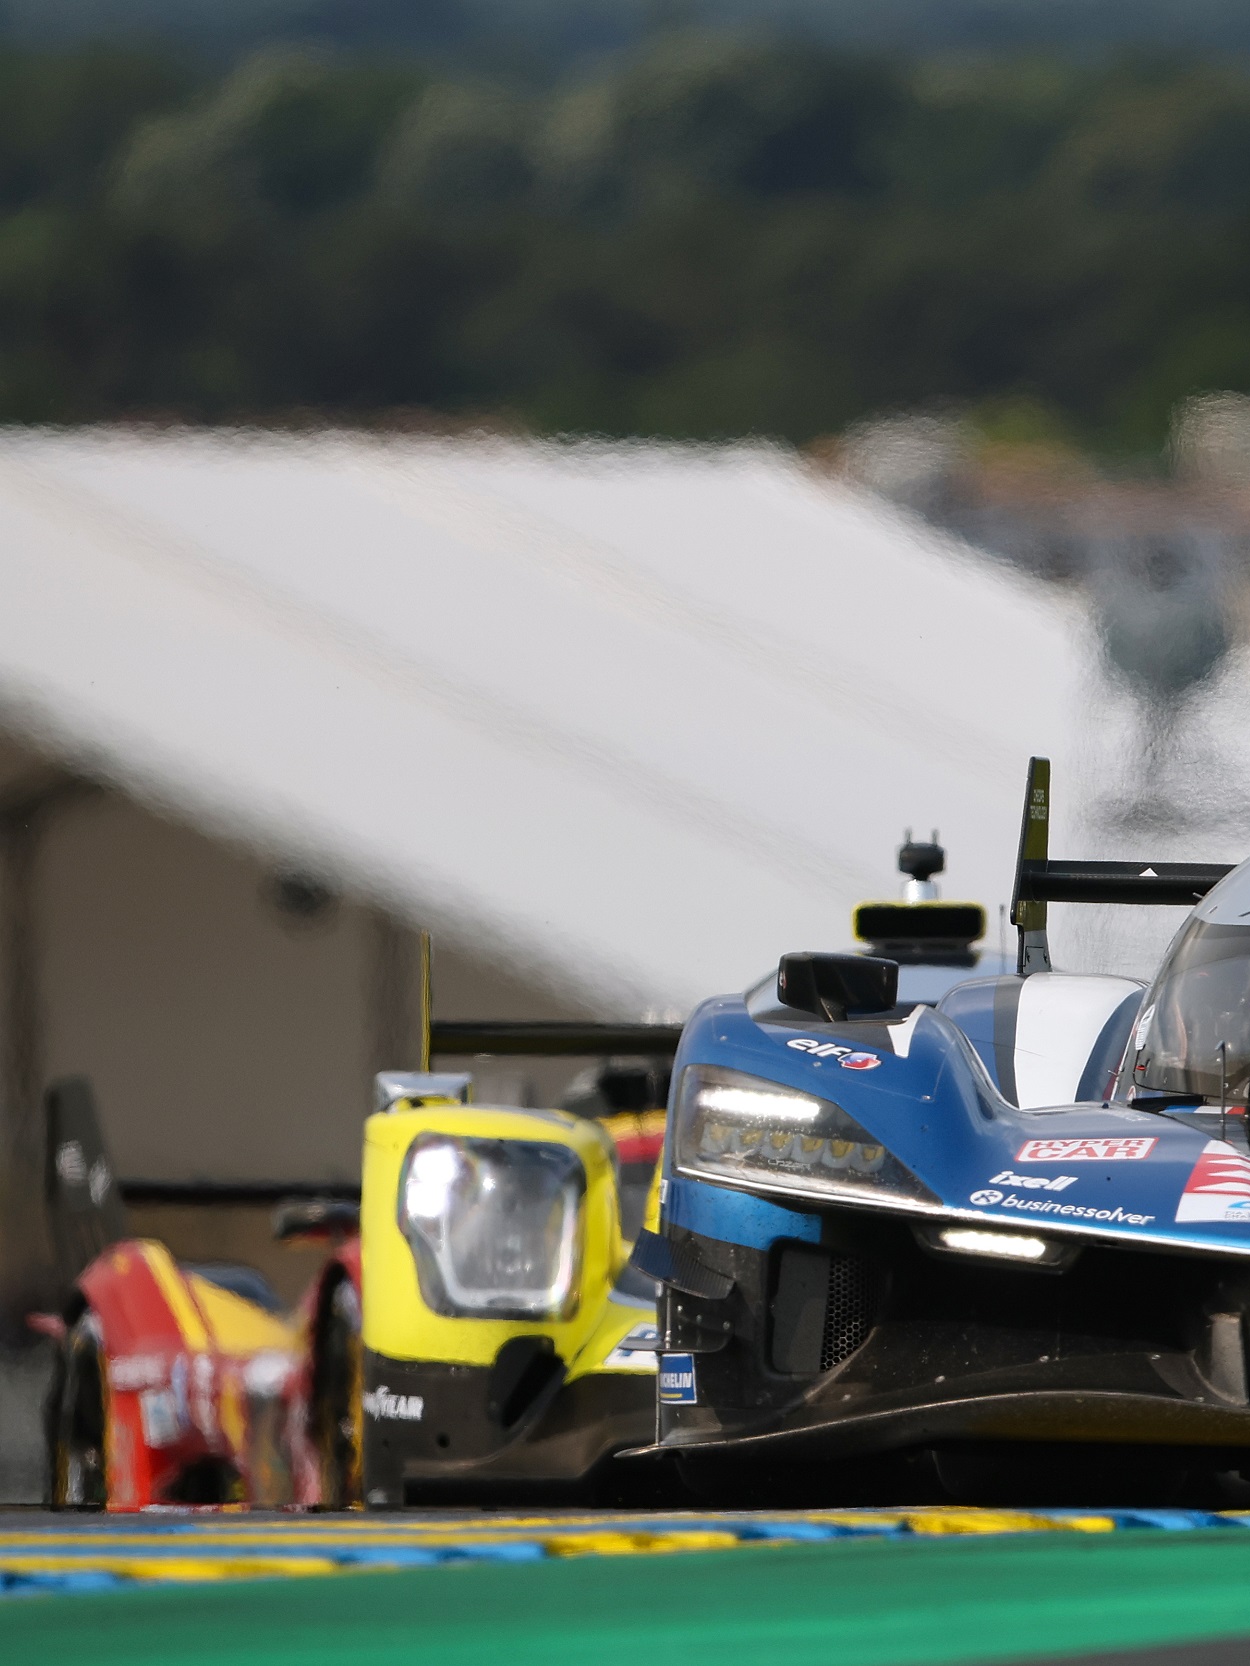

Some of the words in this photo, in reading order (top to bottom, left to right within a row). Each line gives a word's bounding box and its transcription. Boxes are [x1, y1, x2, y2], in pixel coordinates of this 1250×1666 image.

[786, 1038, 852, 1058] elf
[1026, 1146, 1139, 1160] CAR
[1032, 1139, 1145, 1148] HYPER
[988, 1170, 1079, 1192] ixell
[1001, 1194, 1156, 1225] businessolver
